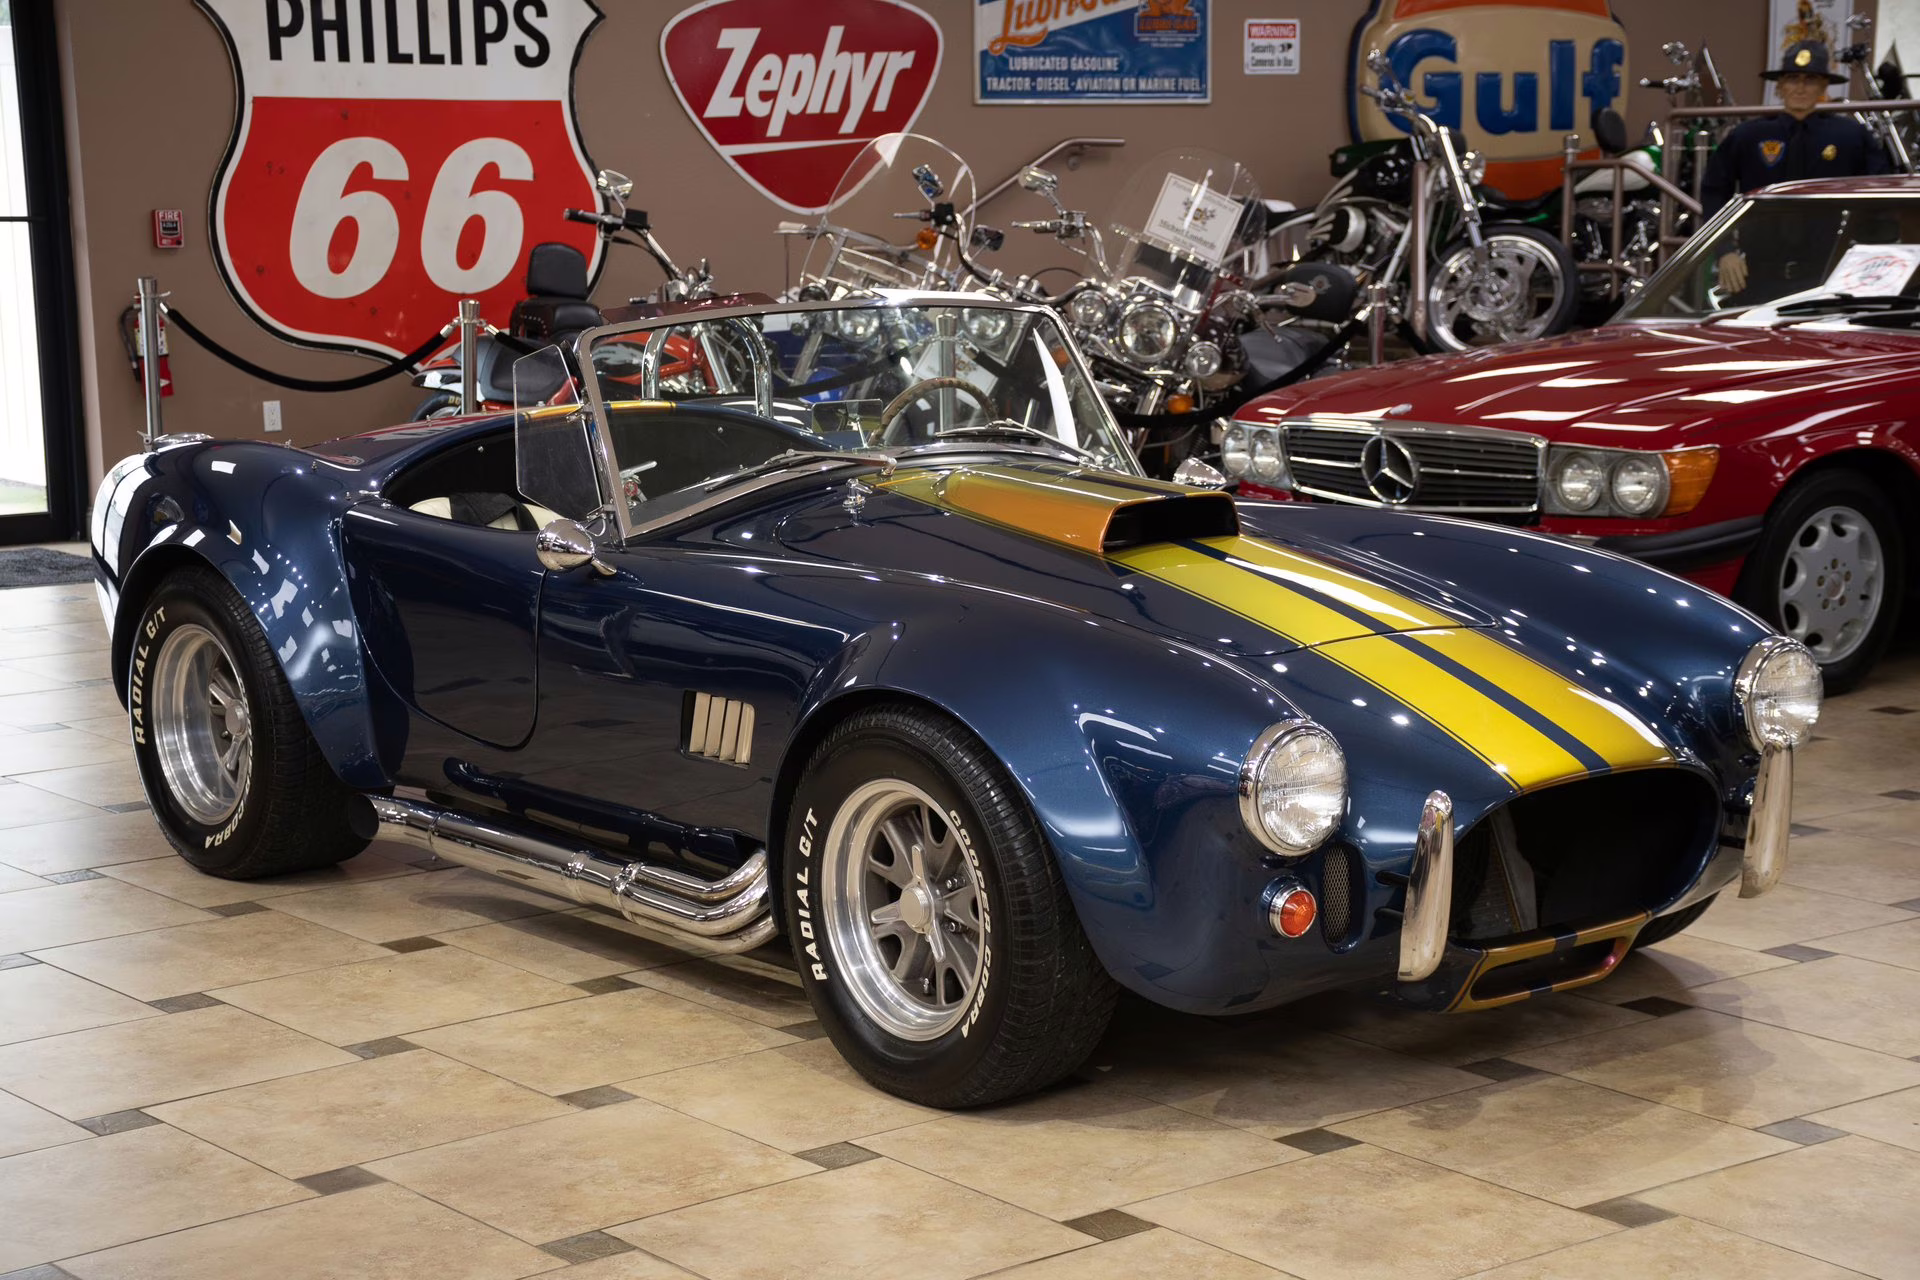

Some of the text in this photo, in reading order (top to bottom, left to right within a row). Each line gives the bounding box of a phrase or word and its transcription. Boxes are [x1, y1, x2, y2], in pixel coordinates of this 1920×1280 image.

[265, 0, 551, 68] PHILLIPS
[1009, 57, 1119, 71] LUBRICATED GASOLINE
[1250, 25, 1296, 37] WARNING
[703, 25, 916, 137] Zephyr
[1122, 77, 1137, 92] OR
[1139, 77, 1176, 92] MARINE
[1177, 77, 1201, 92] FUEL
[1379, 28, 1625, 135] Gulf
[159, 211, 178, 220] FIRE
[290, 136, 535, 299] 66
[132, 606, 166, 744] RADIAL G/T
[204, 799, 245, 849] COBRA
[797, 808, 828, 981] RADIAL G/T
[949, 809, 992, 1039] COOPER COBRA
